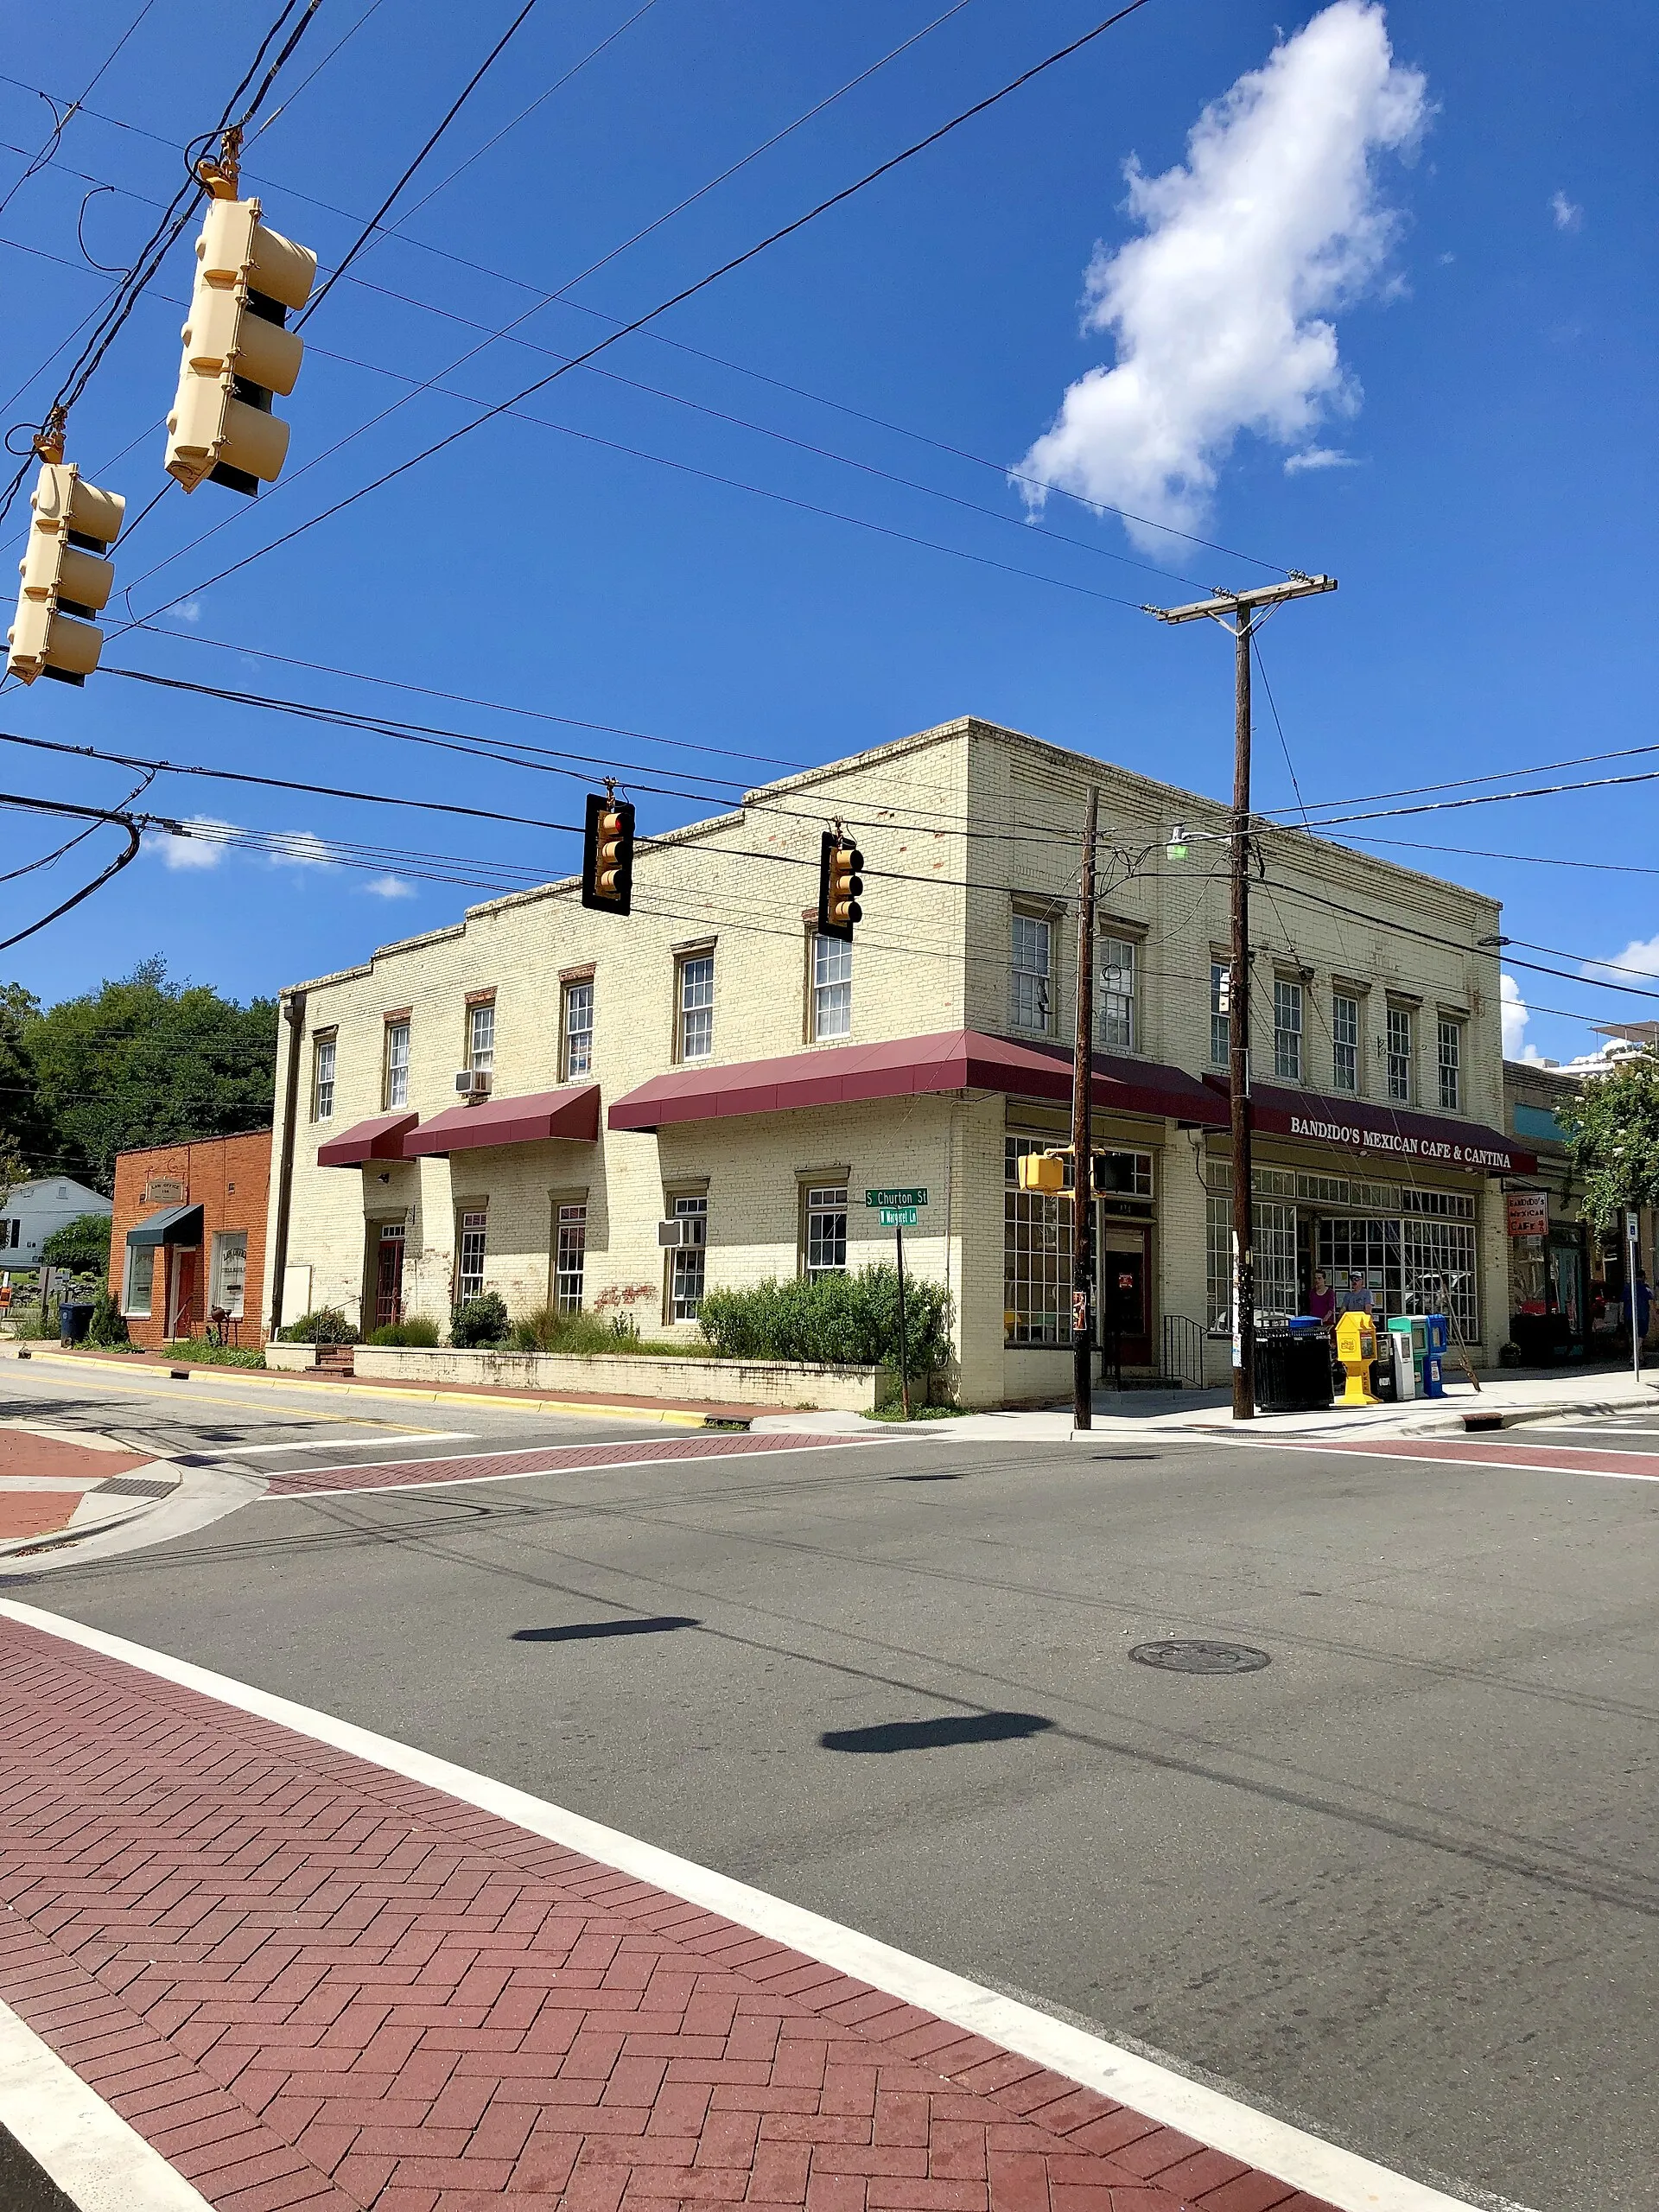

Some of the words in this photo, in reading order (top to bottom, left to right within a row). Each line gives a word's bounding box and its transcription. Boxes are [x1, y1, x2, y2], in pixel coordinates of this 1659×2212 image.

[1291, 1116, 1360, 1144] BANDIDO'S
[1363, 1130, 1418, 1154] MEXICAN
[1421, 1141, 1452, 1159] CAFE
[1453, 1147, 1462, 1160] &
[1465, 1147, 1511, 1168] CANTINA
[867, 1192, 873, 1205] S
[878, 1192, 912, 1205] Churton
[918, 1191, 927, 1204] St
[880, 1211, 885, 1224] W
[887, 1210, 908, 1226] Margaret
[910, 1209, 917, 1223] Ln
